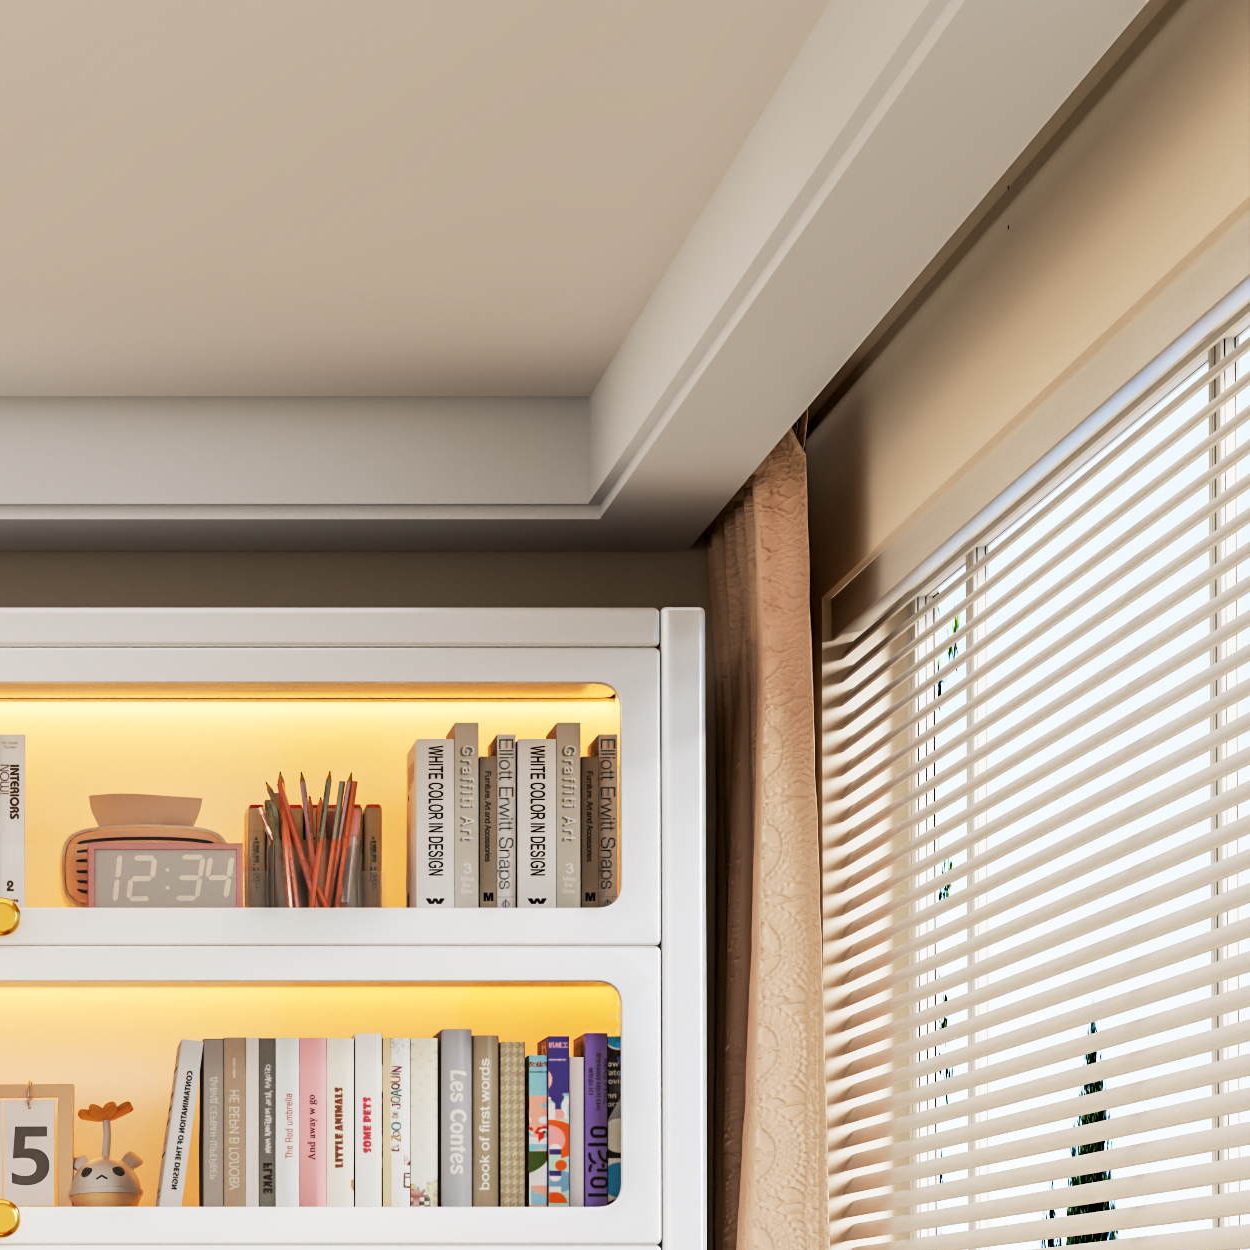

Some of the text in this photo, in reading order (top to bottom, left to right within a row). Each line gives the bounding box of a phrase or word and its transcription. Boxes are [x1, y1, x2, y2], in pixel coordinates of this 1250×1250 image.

[0, 764, 9, 795] NOW!
[9, 764, 20, 820] INTERIORS
[428, 745, 444, 876] WHITE COLOR IN DESIGN
[459, 745, 475, 842] Graffiti Art
[484, 770, 492, 863] Furniture, Art and Accessories
[6, 880, 14, 892] 2
[112, 854, 235, 902] 12:34
[463, 862, 473, 875] 3
[483, 892, 494, 901] M
[284, 1093, 294, 1159] The Red umbrella
[307, 1094, 318, 1160] And away w go
[334, 1087, 344, 1169] LITTLE ANIMALS
[362, 1096, 372, 1154] SOME PETS
[449, 1069, 468, 1175] Les Contes
[478, 1057, 491, 1191] book of first words
